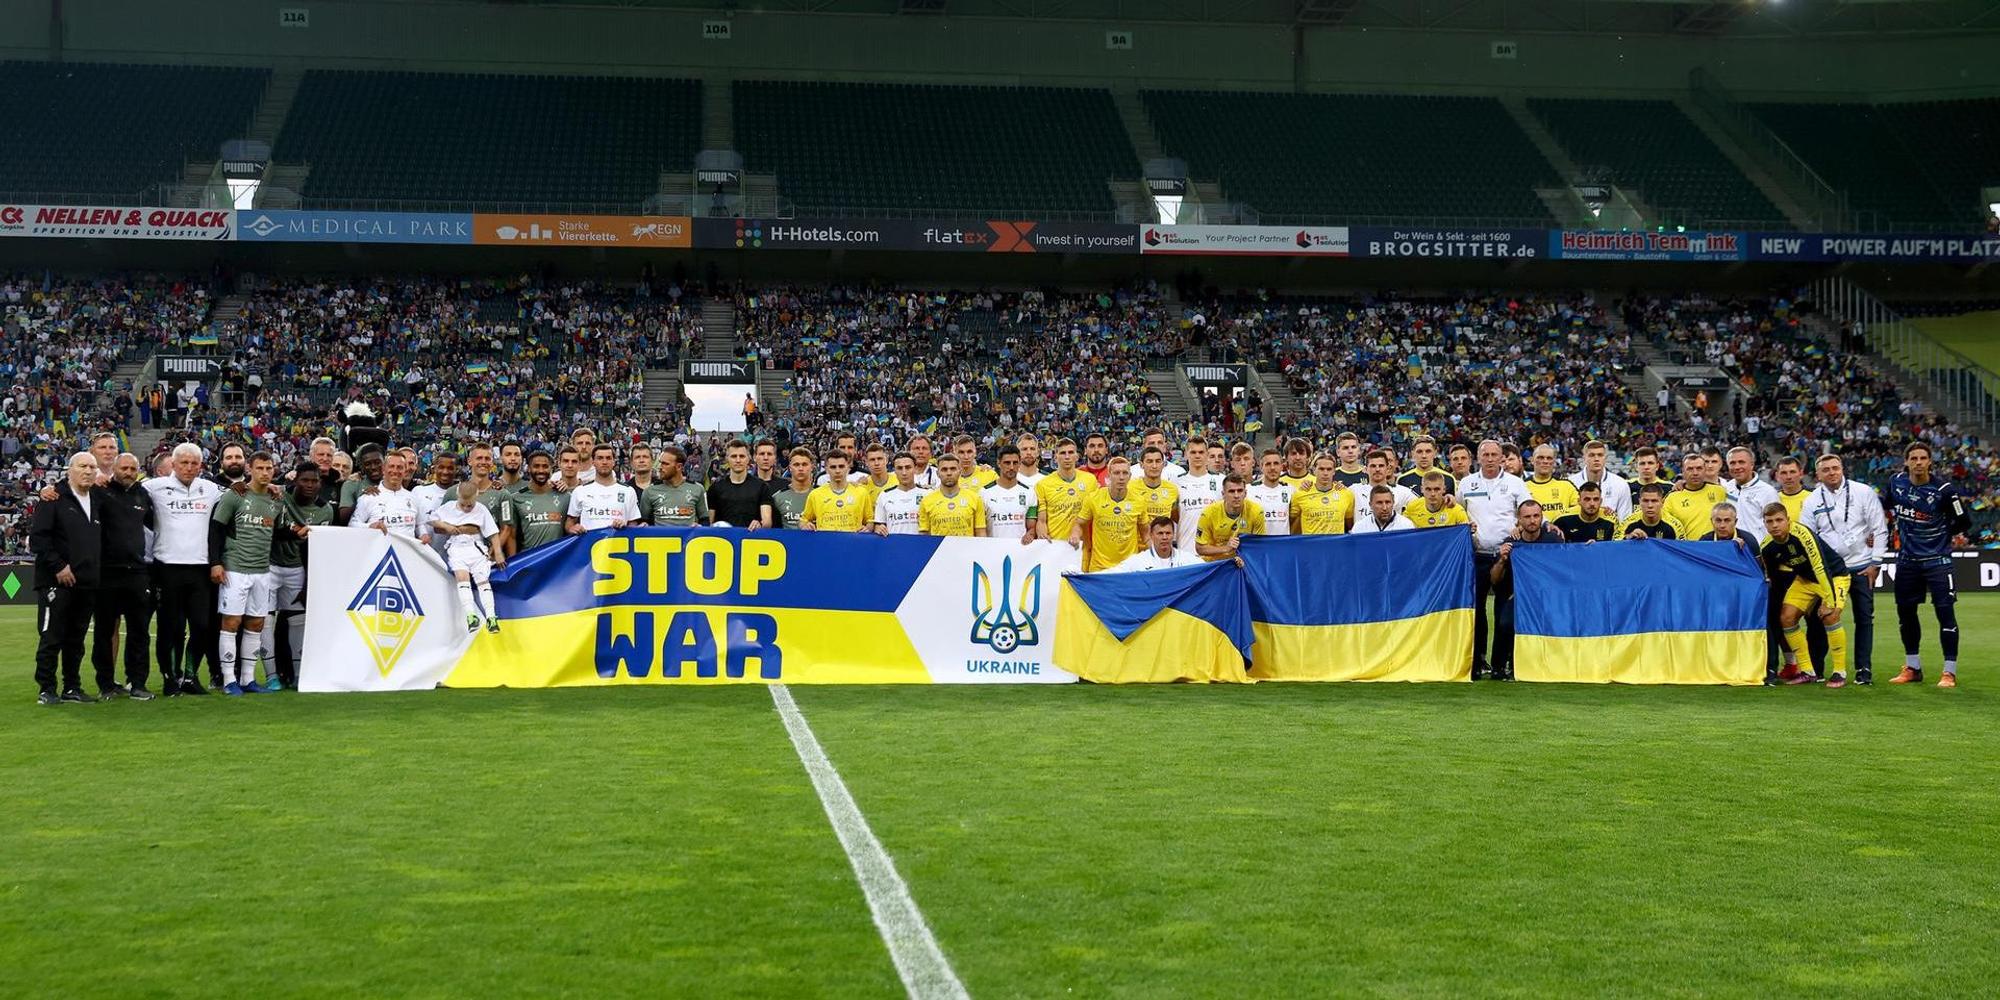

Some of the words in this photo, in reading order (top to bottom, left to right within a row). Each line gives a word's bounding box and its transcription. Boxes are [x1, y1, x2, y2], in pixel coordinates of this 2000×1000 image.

[283, 12, 305, 22] 11A
[705, 25, 728, 34] 10A
[1111, 36, 1127, 45] 9A
[223, 162, 254, 173] PUMA
[698, 171, 728, 182] PUMA
[35, 207, 122, 225] NELLEN
[124, 209, 141, 226] &
[148, 209, 228, 228] QUACK
[32, 226, 106, 235] SPEDITION
[112, 228, 139, 236] UND
[146, 228, 208, 237] LOGISTIK
[289, 219, 397, 235] MEDICAL
[410, 221, 468, 236] PARK
[559, 221, 590, 231] Starke
[657, 224, 682, 235] EGN
[559, 231, 619, 242] Viererkette.
[770, 226, 879, 242] H-Hotels.com
[923, 228, 988, 243] flatex
[1036, 233, 1071, 244] Invest
[1074, 234, 1085, 245] in
[1088, 235, 1135, 248] yourself
[1205, 234, 1225, 243] Your
[1227, 234, 1257, 245] Project
[1259, 235, 1290, 243] Partner
[1393, 232, 1410, 241] Der
[1411, 232, 1435, 241] Wein
[1437, 232, 1444, 241] &
[1445, 232, 1465, 241] Sekt
[1471, 232, 1487, 241] seit
[1489, 232, 1511, 242] 1600
[1562, 232, 1644, 250] Heinrich
[1370, 241, 1535, 257] BROGSITTER.de
[1761, 238, 1801, 254] NEW
[1823, 239, 1887, 255] POWER
[163, 358, 208, 373] PUMA
[690, 363, 732, 377] PUMA
[1186, 366, 1226, 380] PUMA
[590, 536, 787, 597] STOP
[594, 611, 783, 679] WAR
[966, 659, 1041, 675] UKRAINE
